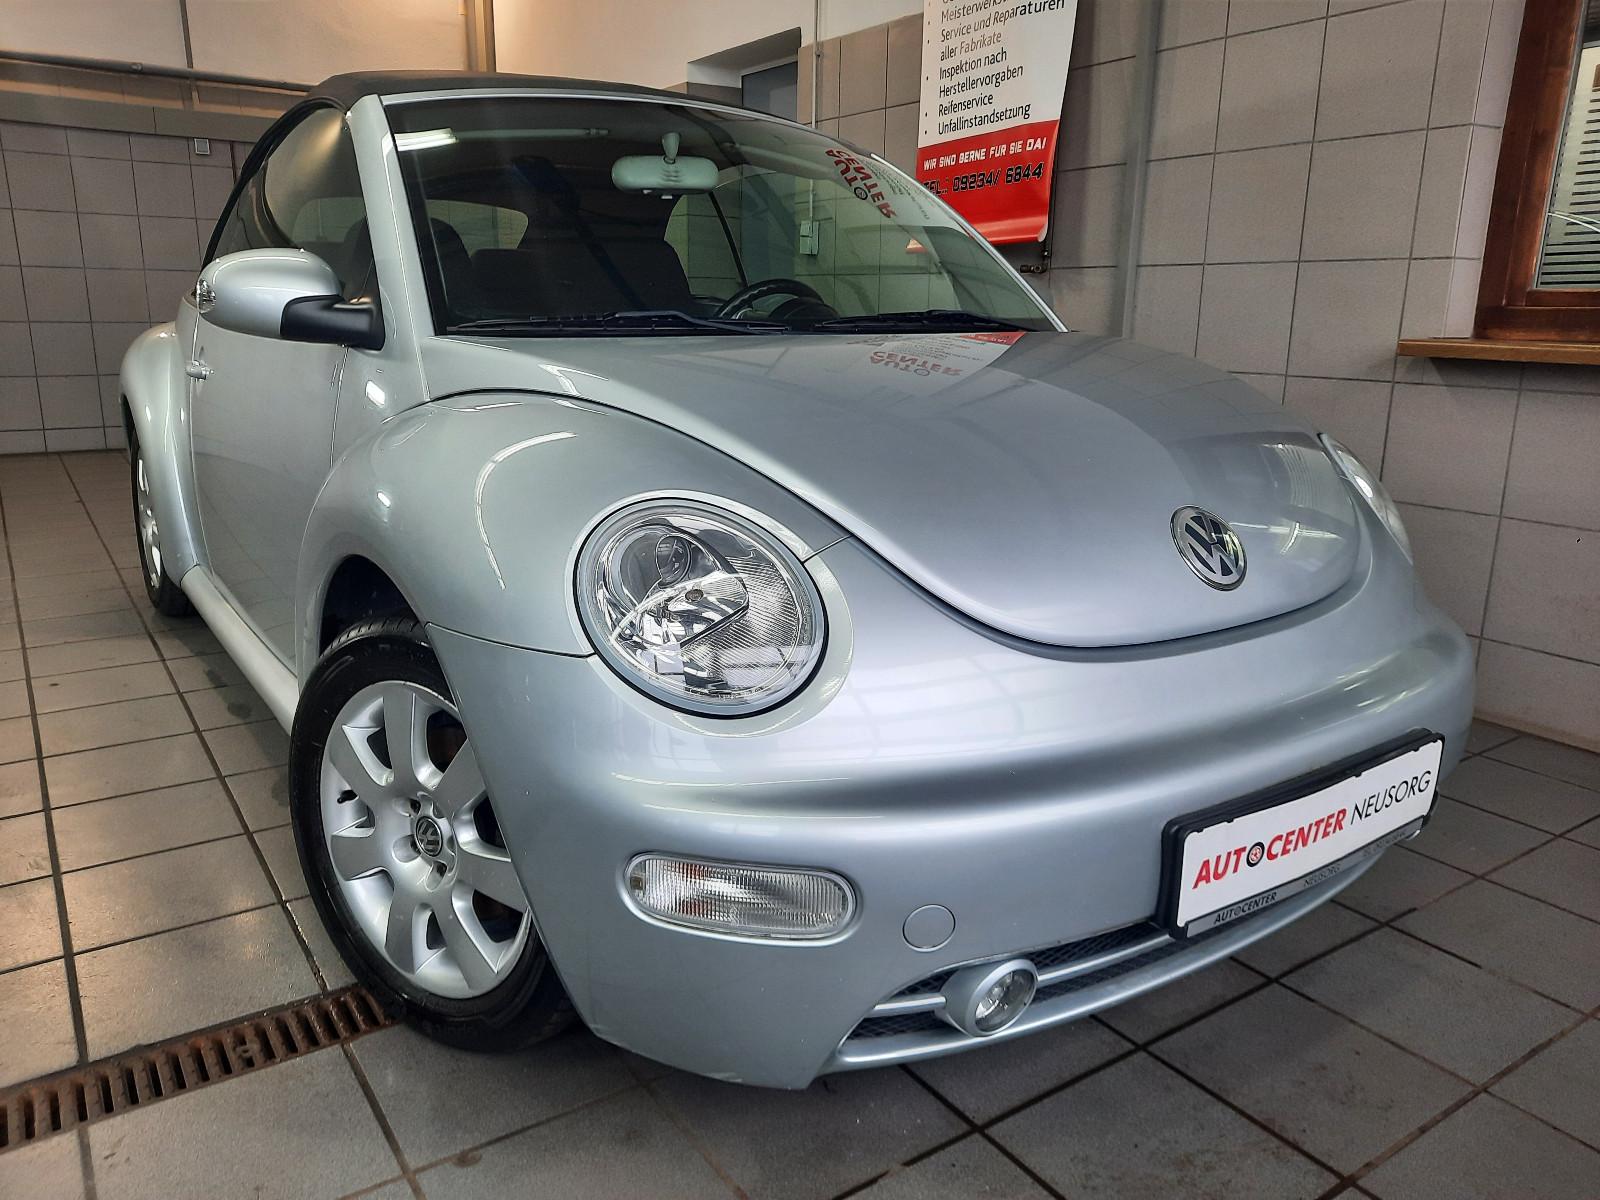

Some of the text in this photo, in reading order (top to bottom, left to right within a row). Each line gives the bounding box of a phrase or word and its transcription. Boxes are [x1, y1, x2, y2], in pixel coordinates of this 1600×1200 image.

[941, 0, 1065, 42] Service und Reparaturen
[940, 31, 1002, 61] aller Fabrikate
[940, 47, 1007, 81] Inspektion nach
[939, 65, 1023, 98] Herstellervorgaben
[938, 103, 1031, 134] Unfallinstandsetzung
[939, 92, 993, 117] Reifenservice
[924, 158, 937, 170] WIR
[1005, 162, 1045, 184] 6844
[1351, 770, 1432, 825] NEUSORG
